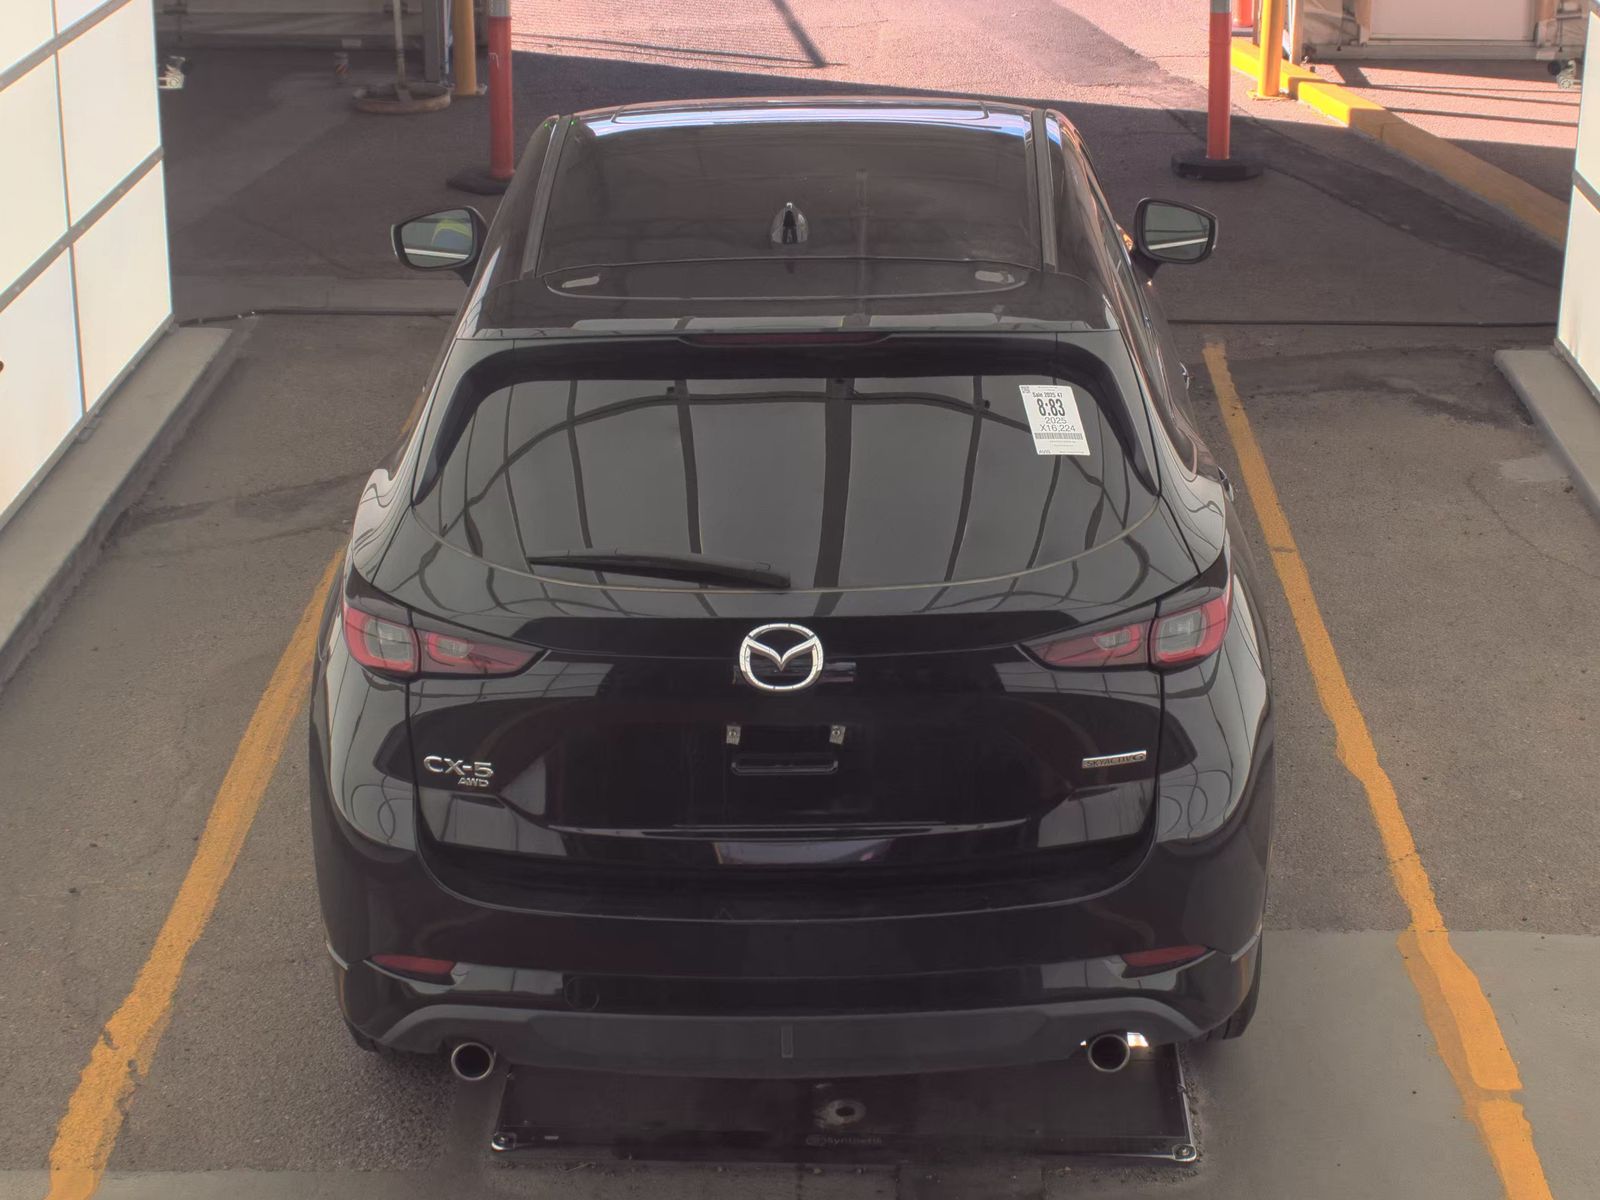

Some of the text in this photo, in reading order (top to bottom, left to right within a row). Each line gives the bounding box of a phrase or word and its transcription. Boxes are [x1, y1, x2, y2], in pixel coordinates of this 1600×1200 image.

[1037, 398, 1065, 417] 8:83
[1044, 416, 1067, 425] 2025
[423, 755, 494, 777] CX-5
[457, 777, 489, 787] AWD
